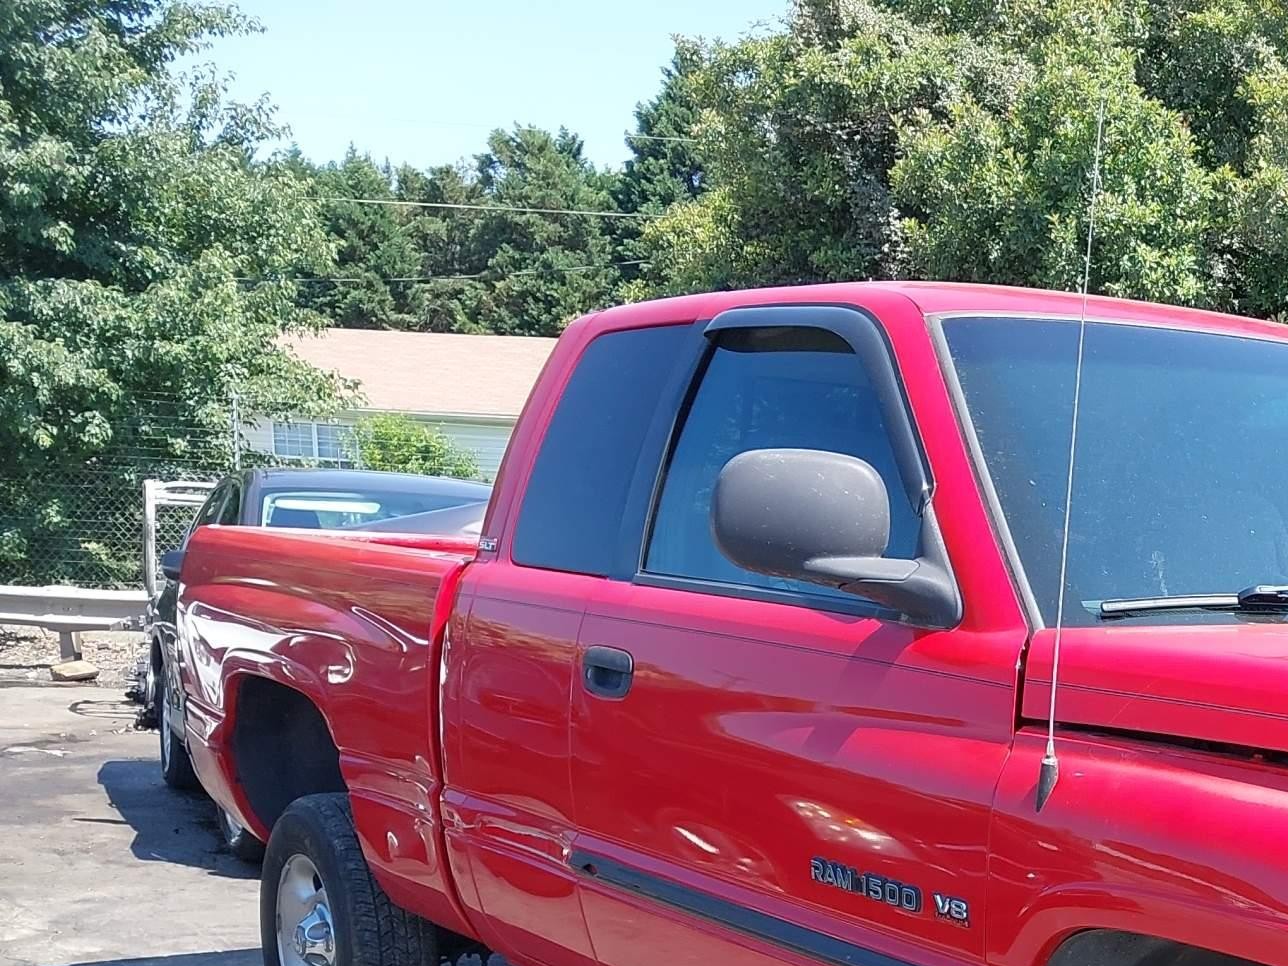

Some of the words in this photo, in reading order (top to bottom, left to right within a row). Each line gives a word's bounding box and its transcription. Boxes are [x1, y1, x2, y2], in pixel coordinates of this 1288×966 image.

[811, 858, 852, 892] RAM
[861, 872, 919, 912] 1500
[933, 893, 968, 920] V8
